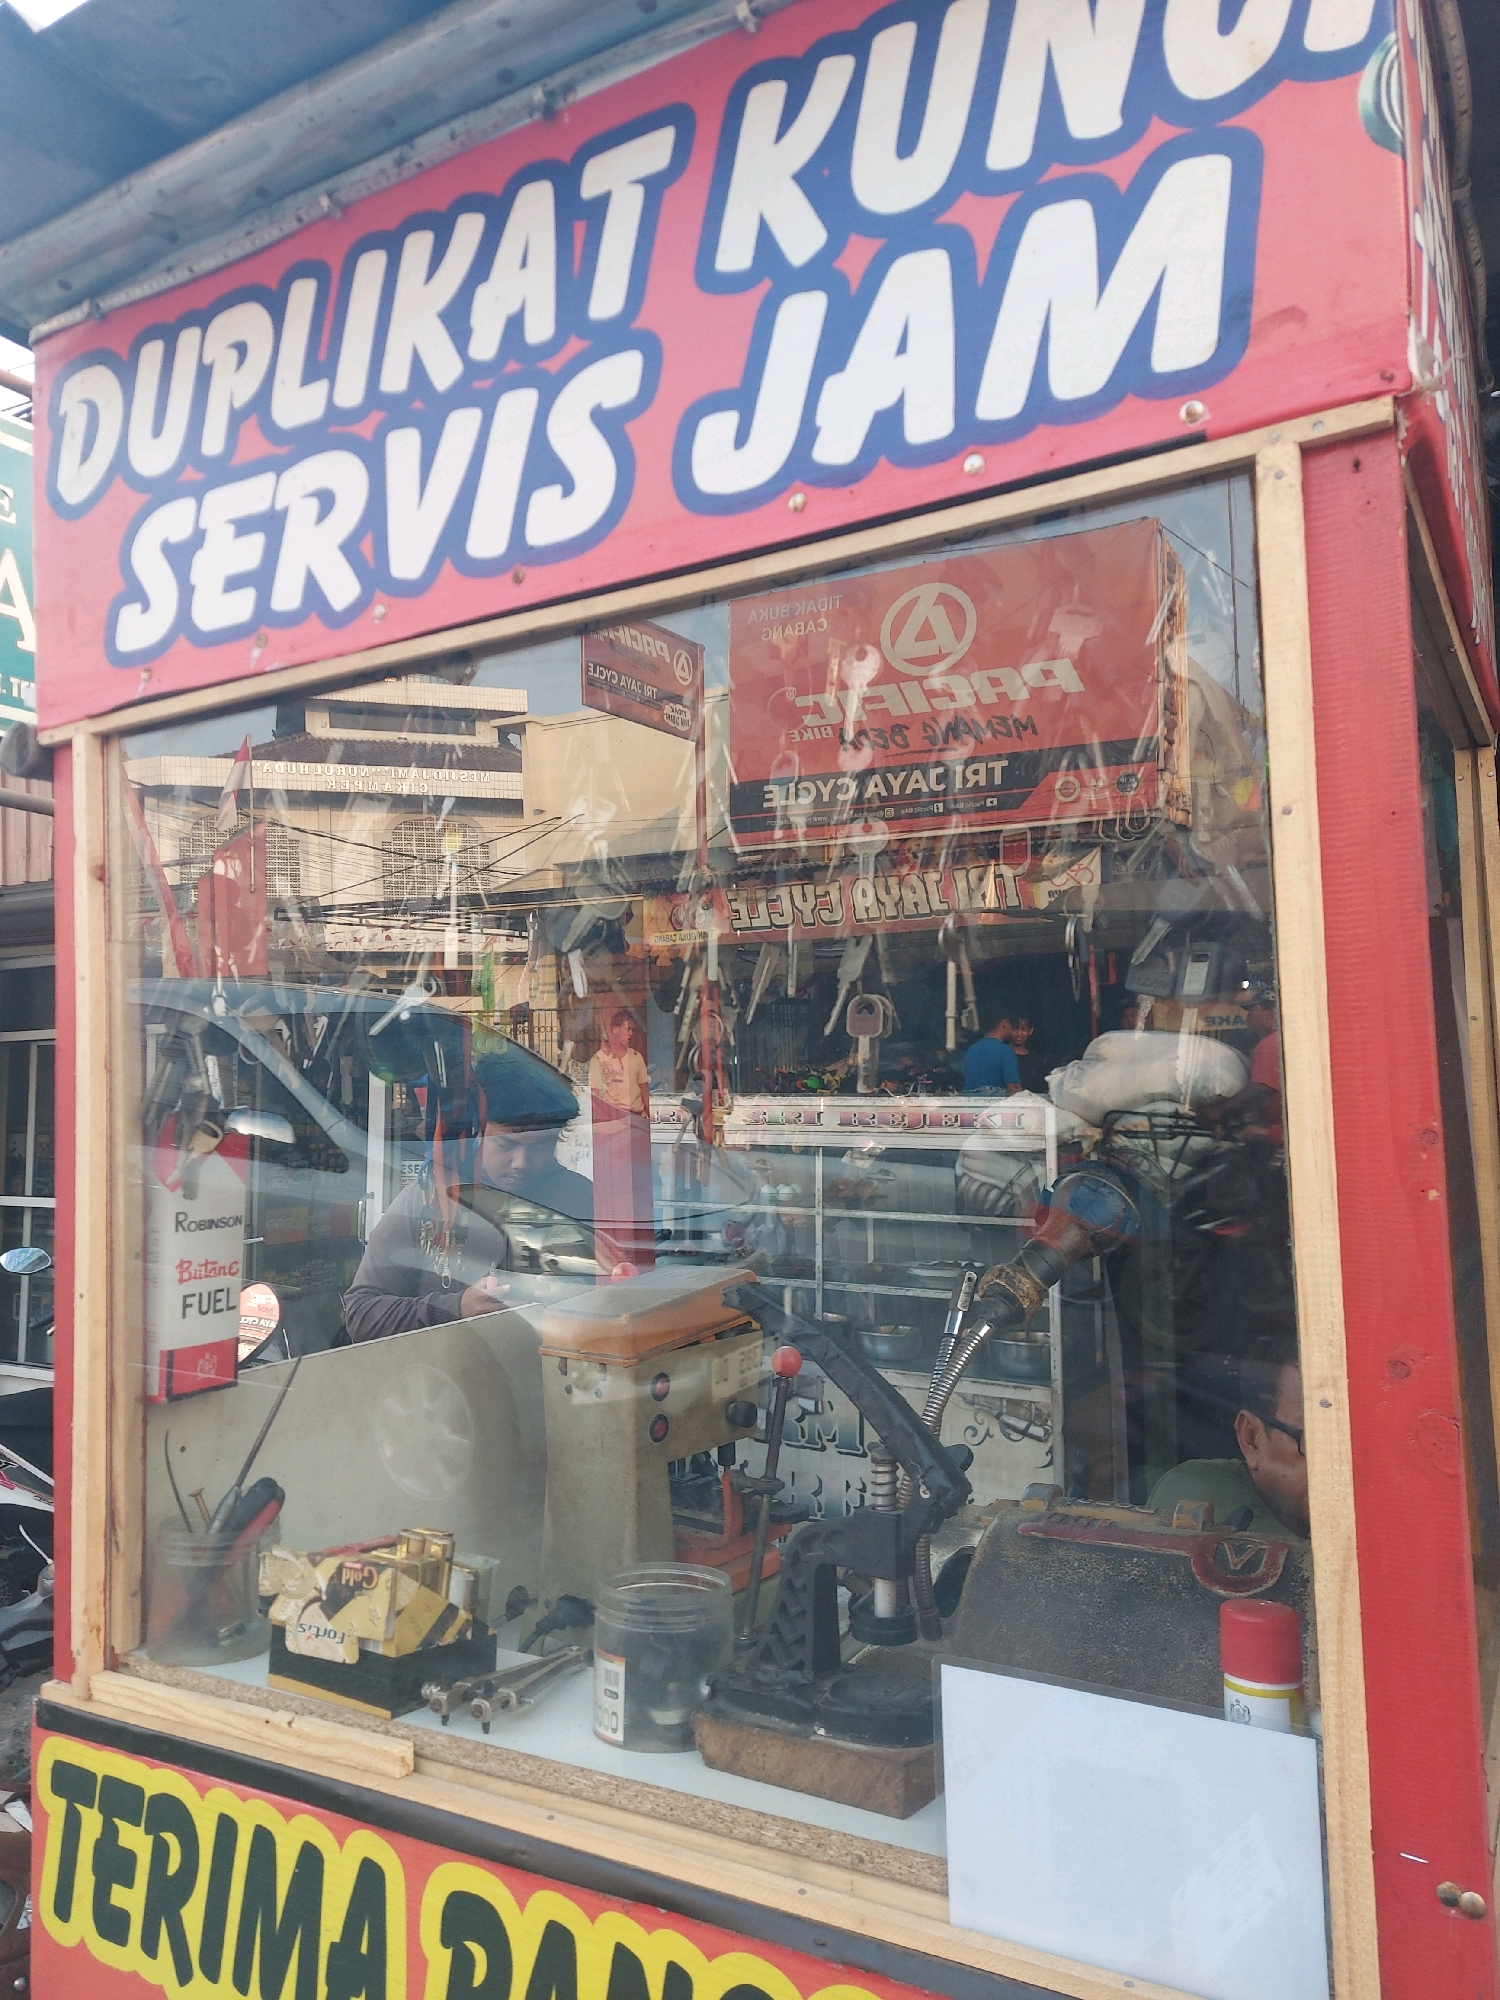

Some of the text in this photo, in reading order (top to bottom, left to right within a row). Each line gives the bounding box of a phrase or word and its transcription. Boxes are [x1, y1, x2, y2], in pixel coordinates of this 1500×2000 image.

[57, 125, 676, 506] DUPLIKAT
[114, 350, 644, 653] SERVIS
[691, 154, 1233, 496] JAM
[838, 1110, 1025, 1130] REJEKI
[175, 1258, 240, 1286] Butane
[181, 1287, 237, 1320] FUEL
[340, 1565, 380, 1591] Gold
[297, 1622, 346, 1645] Fortis
[49, 1759, 388, 2000] TERIMA
